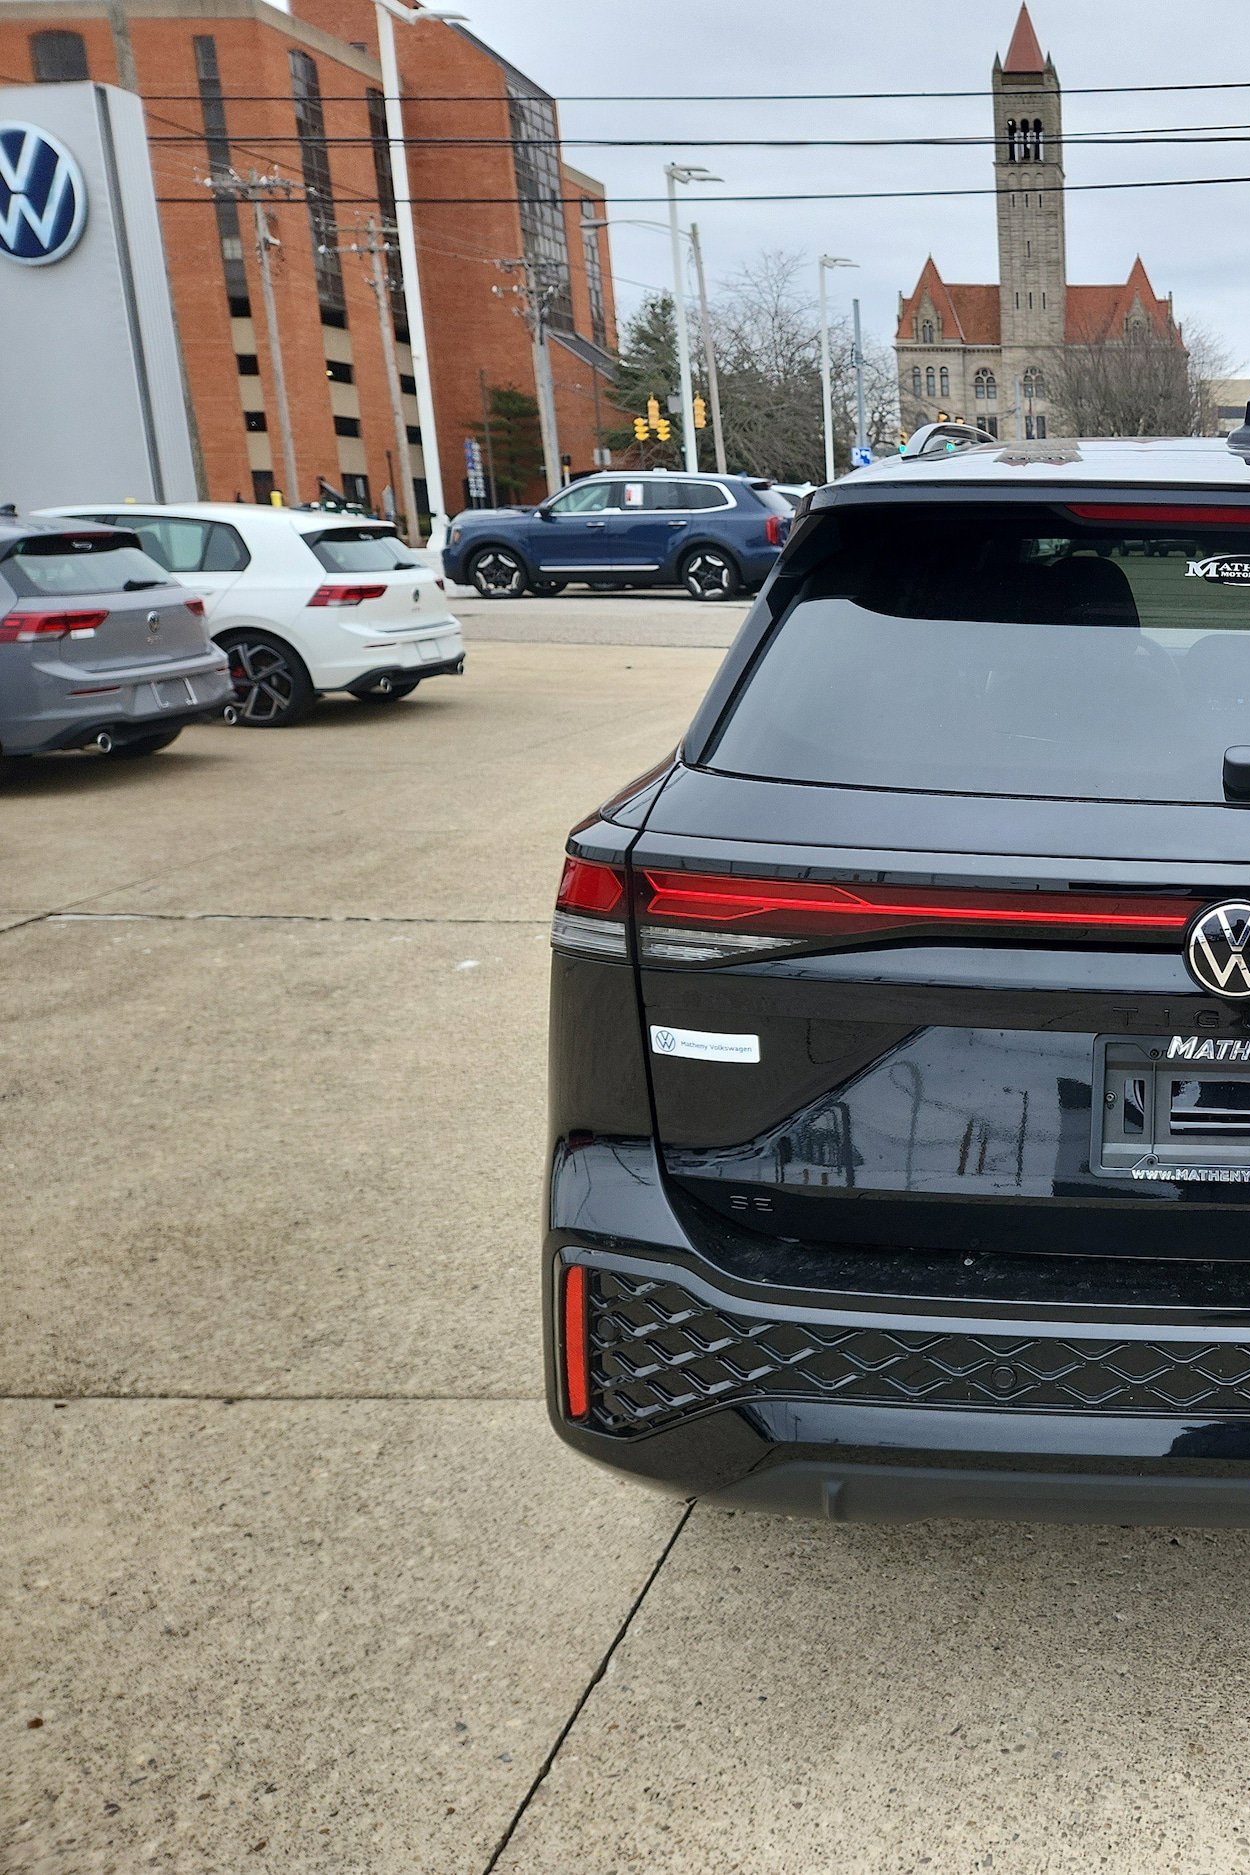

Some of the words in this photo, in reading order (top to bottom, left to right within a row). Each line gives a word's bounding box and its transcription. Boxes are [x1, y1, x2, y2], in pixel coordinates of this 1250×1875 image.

[680, 1041, 708, 1051] Matheny
[710, 1044, 752, 1053] Volkswagen
[729, 1195, 774, 1211] SE
